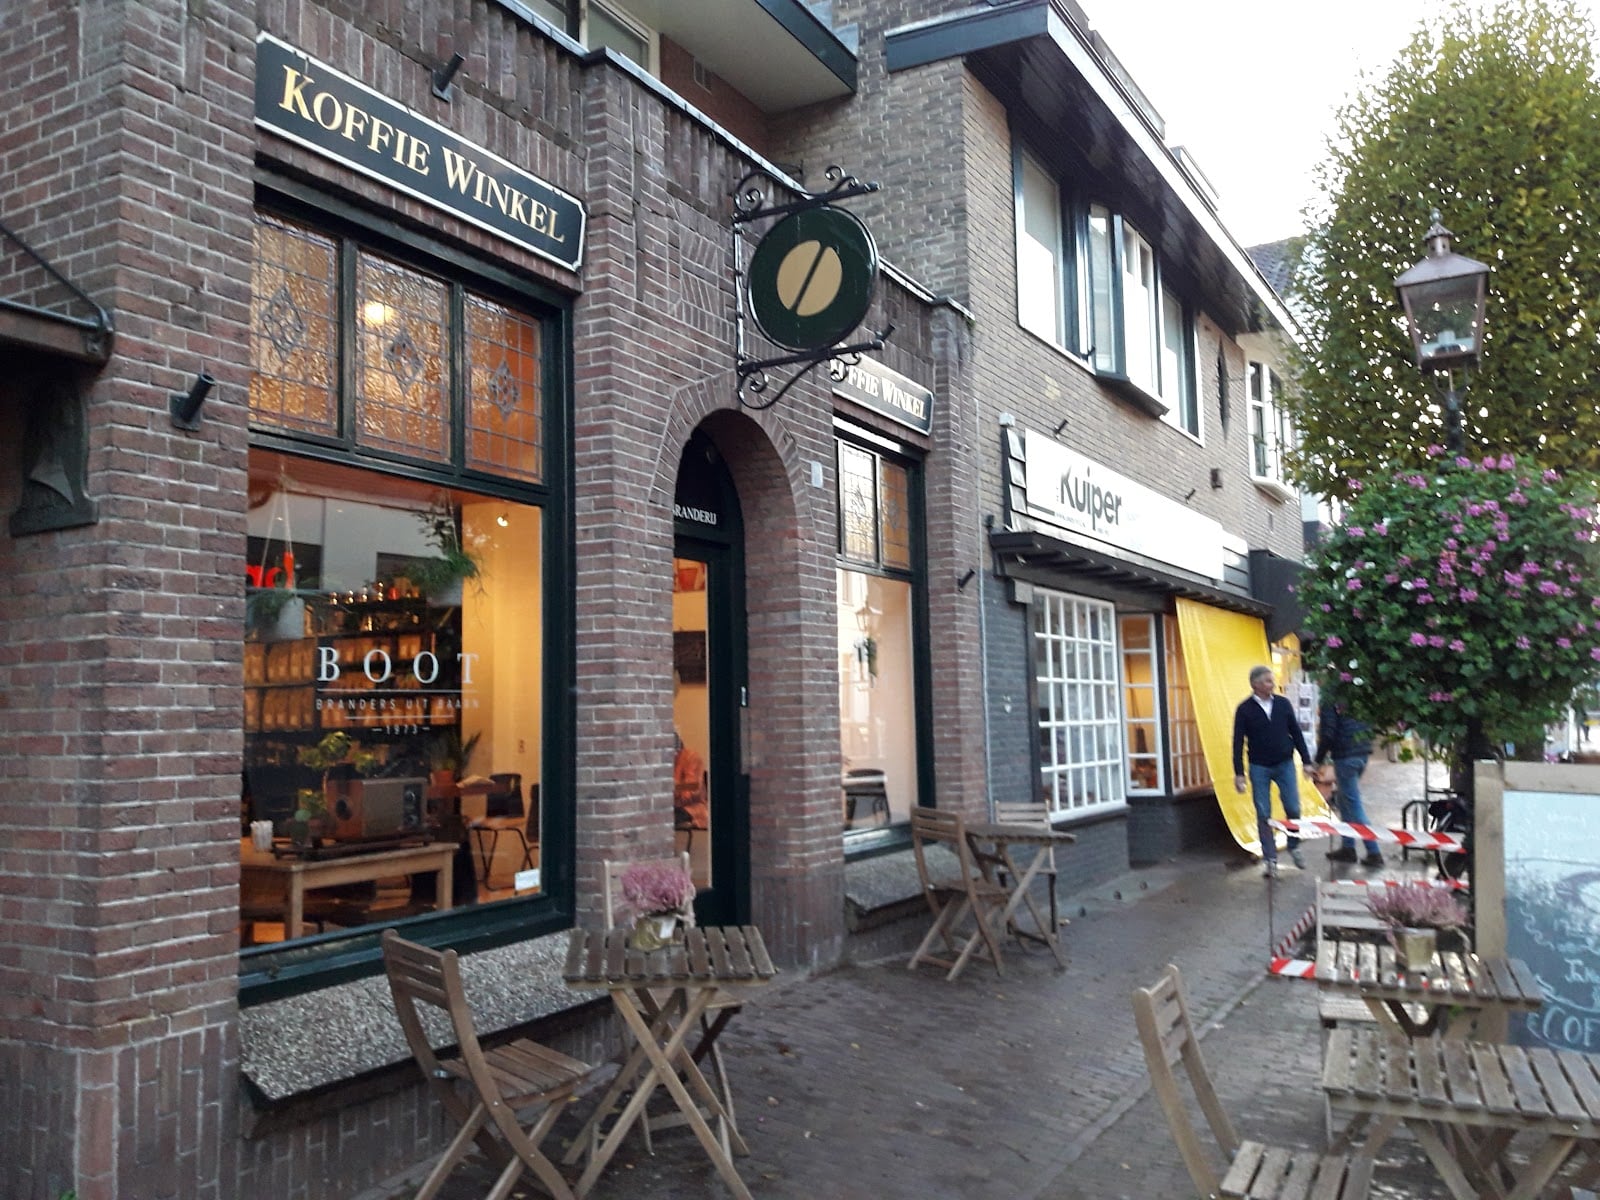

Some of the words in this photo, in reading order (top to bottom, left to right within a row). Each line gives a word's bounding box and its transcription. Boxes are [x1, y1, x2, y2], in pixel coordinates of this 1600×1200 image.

[278, 64, 431, 176] KOFFIE
[442, 146, 565, 243] WINKEL
[881, 377, 927, 420] WINKEL
[672, 504, 717, 526] RANDERIJ
[1060, 464, 1122, 531] Kuiper
[316, 646, 480, 684] BOOT
[315, 698, 396, 710] BRANDERS
[405, 698, 428, 710] UIT
